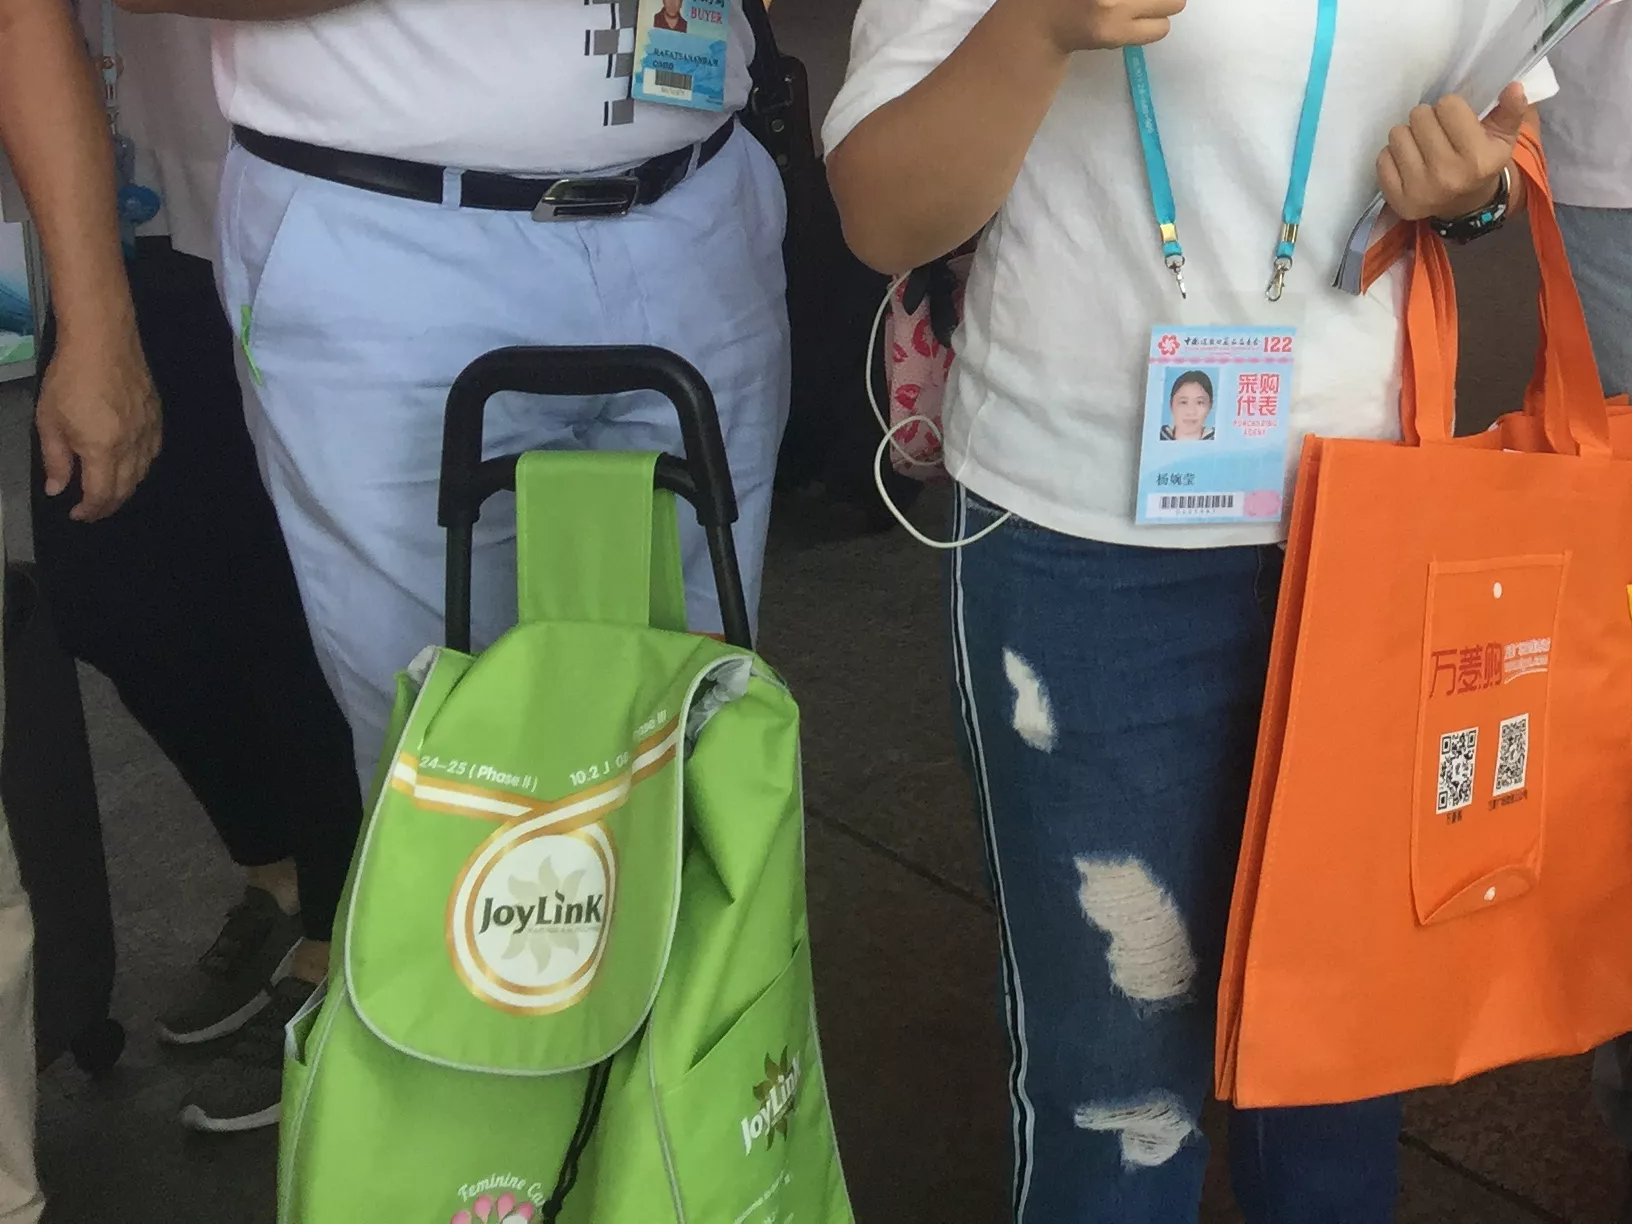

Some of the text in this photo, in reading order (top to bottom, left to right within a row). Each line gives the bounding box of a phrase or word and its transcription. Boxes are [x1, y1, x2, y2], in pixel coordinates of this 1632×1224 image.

[690, 7, 723, 25] BUYER
[1263, 336, 1293, 353] 122
[1238, 373, 1280, 394] 采购
[1236, 395, 1277, 416] 代表
[1429, 641, 1503, 699] 万菱购
[457, 1172, 527, 1203] Feminine
